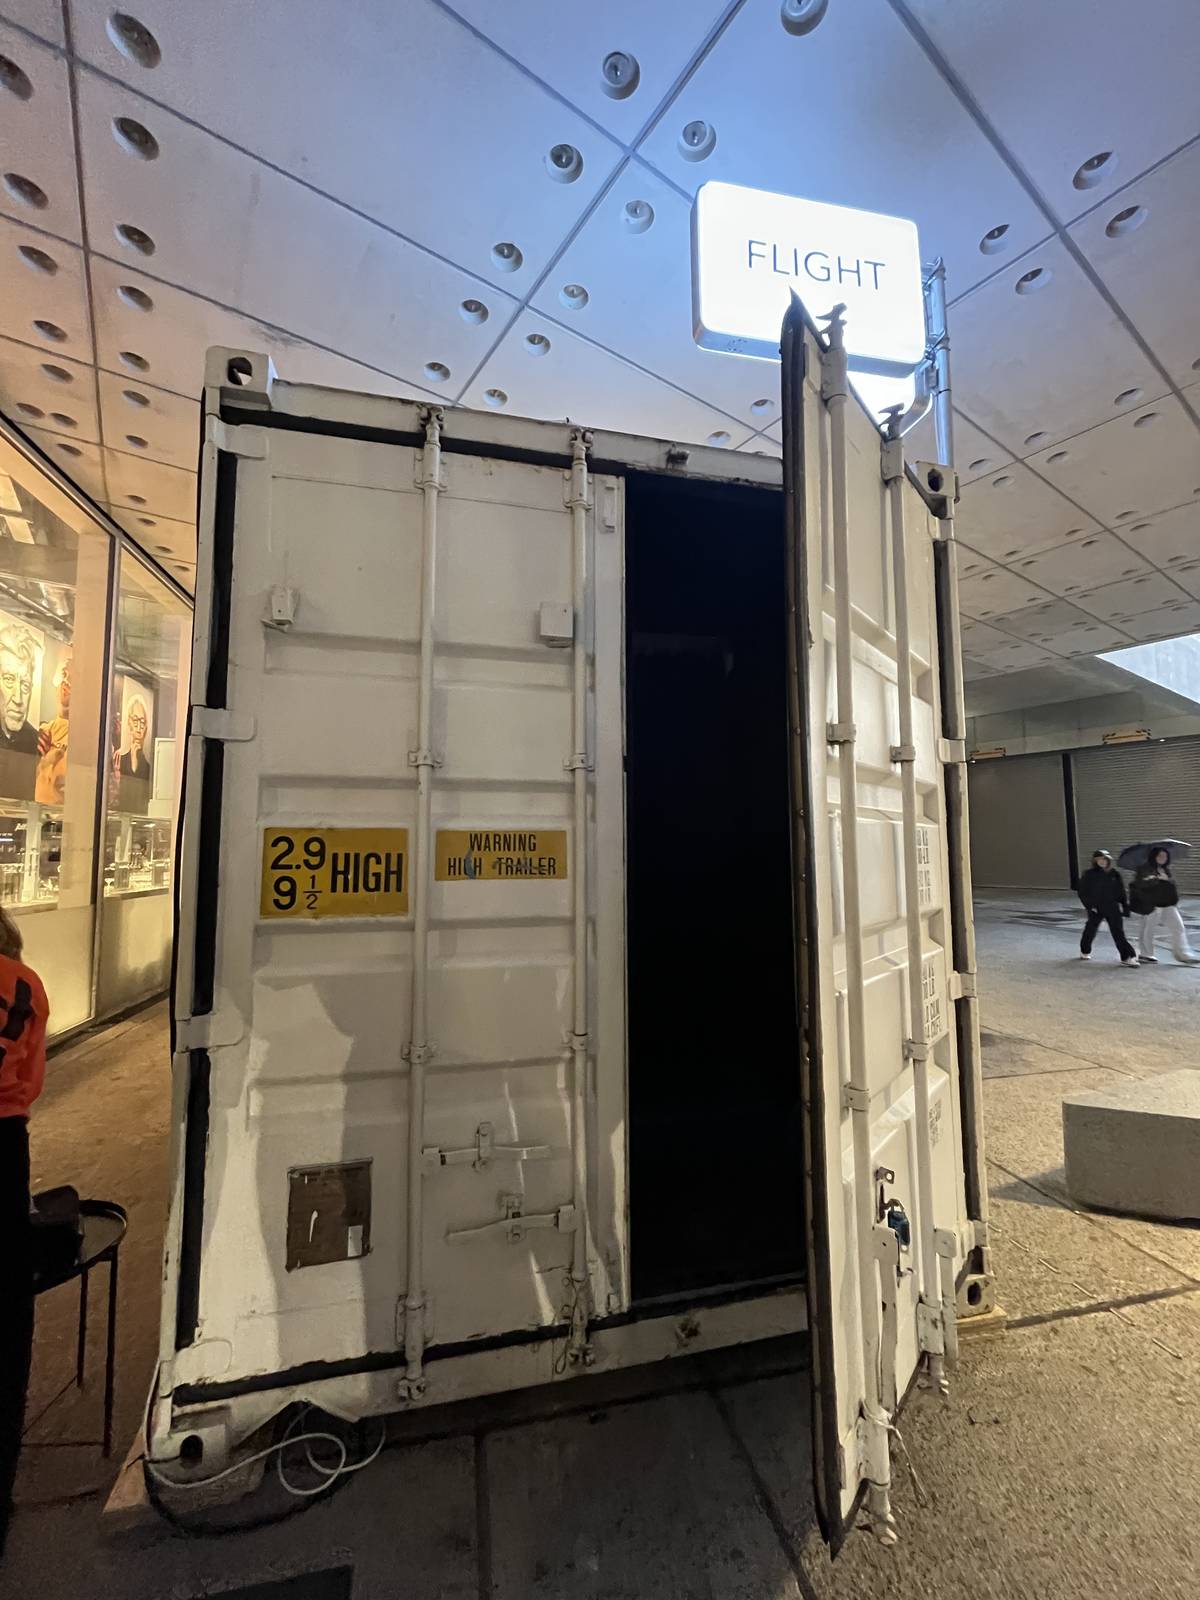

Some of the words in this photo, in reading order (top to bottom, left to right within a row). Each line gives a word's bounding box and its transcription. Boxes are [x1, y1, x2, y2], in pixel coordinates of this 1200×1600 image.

[748, 239, 886, 291] FLIGHT
[270, 835, 326, 871] 2.9
[469, 833, 537, 852] WARNING
[330, 852, 404, 893] HIGH
[495, 856, 557, 876] TRAILER
